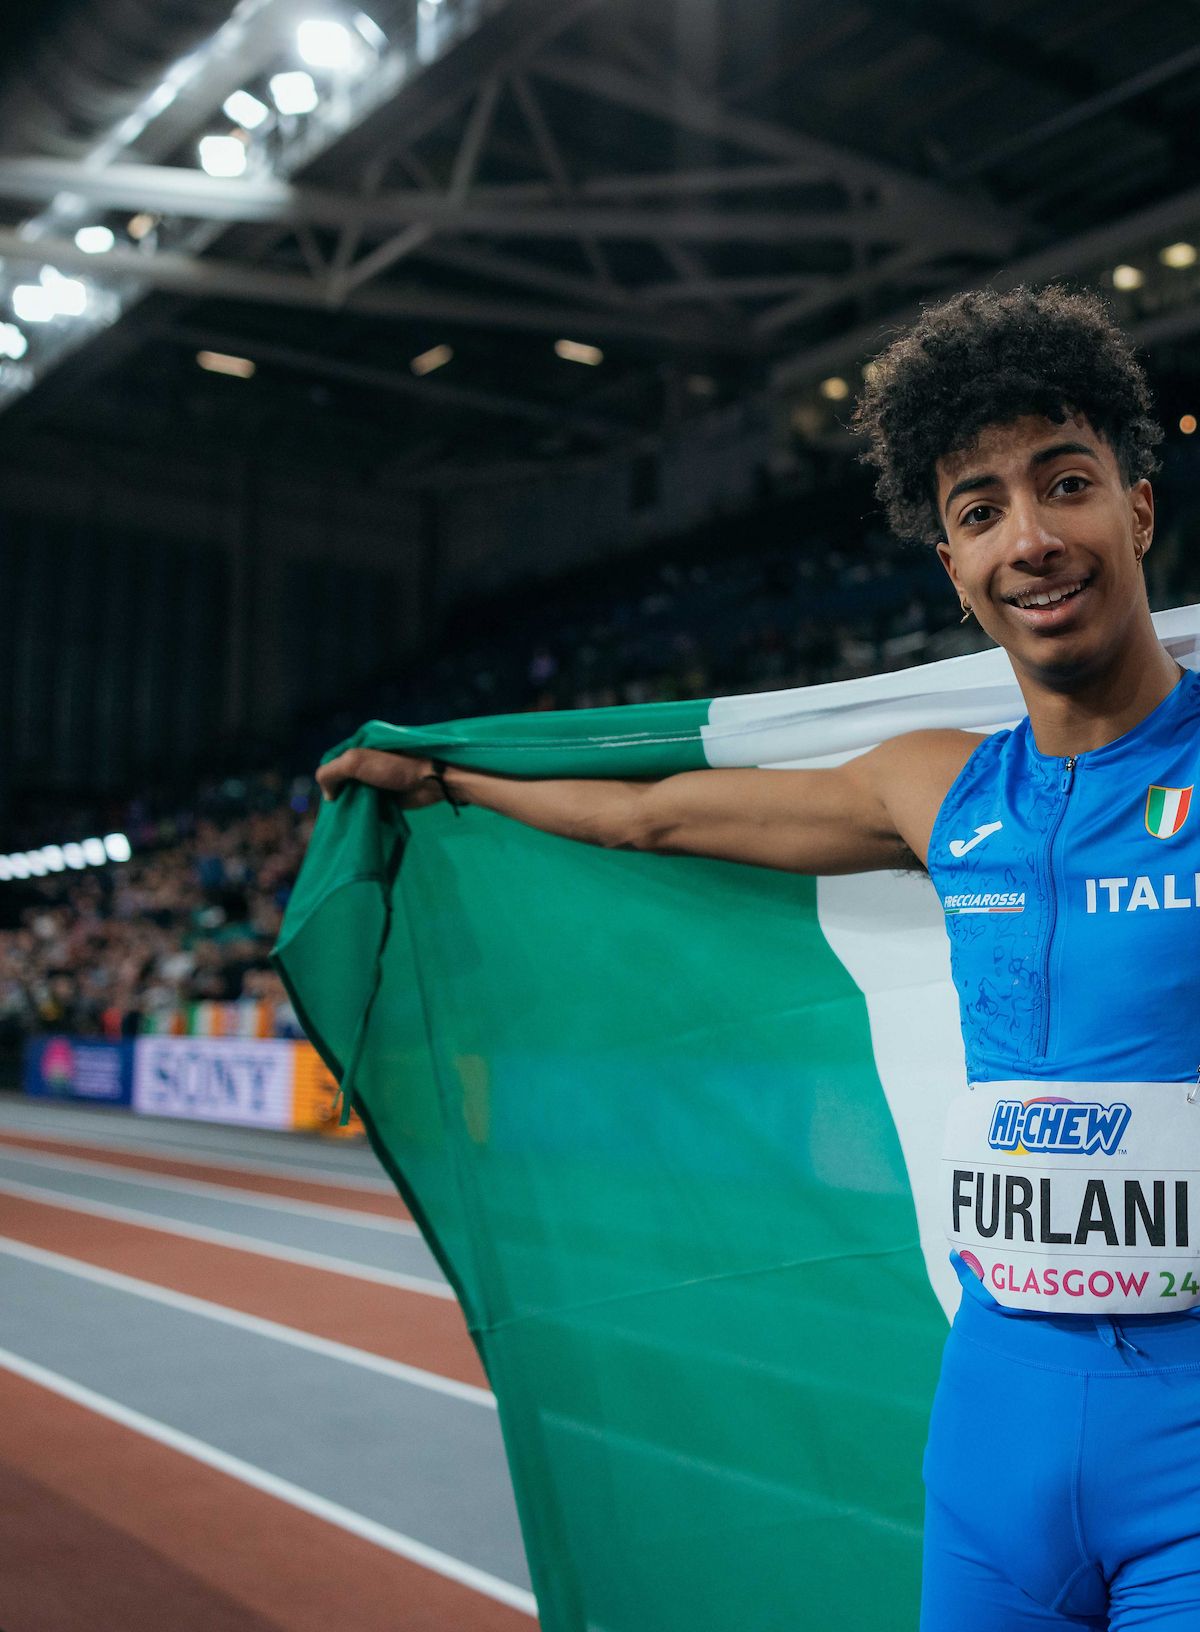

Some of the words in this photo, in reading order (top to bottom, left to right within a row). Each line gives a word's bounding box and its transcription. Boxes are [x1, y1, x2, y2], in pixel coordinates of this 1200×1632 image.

[944, 893, 1025, 907] FRECCIAROSSA
[153, 1048, 276, 1113] SONY
[988, 1100, 1131, 1155] HI-CHEW
[952, 1169, 1189, 1247] FURLANI
[991, 1263, 1149, 1297] GLASGOW
[1159, 1271, 1200, 1297] 24
